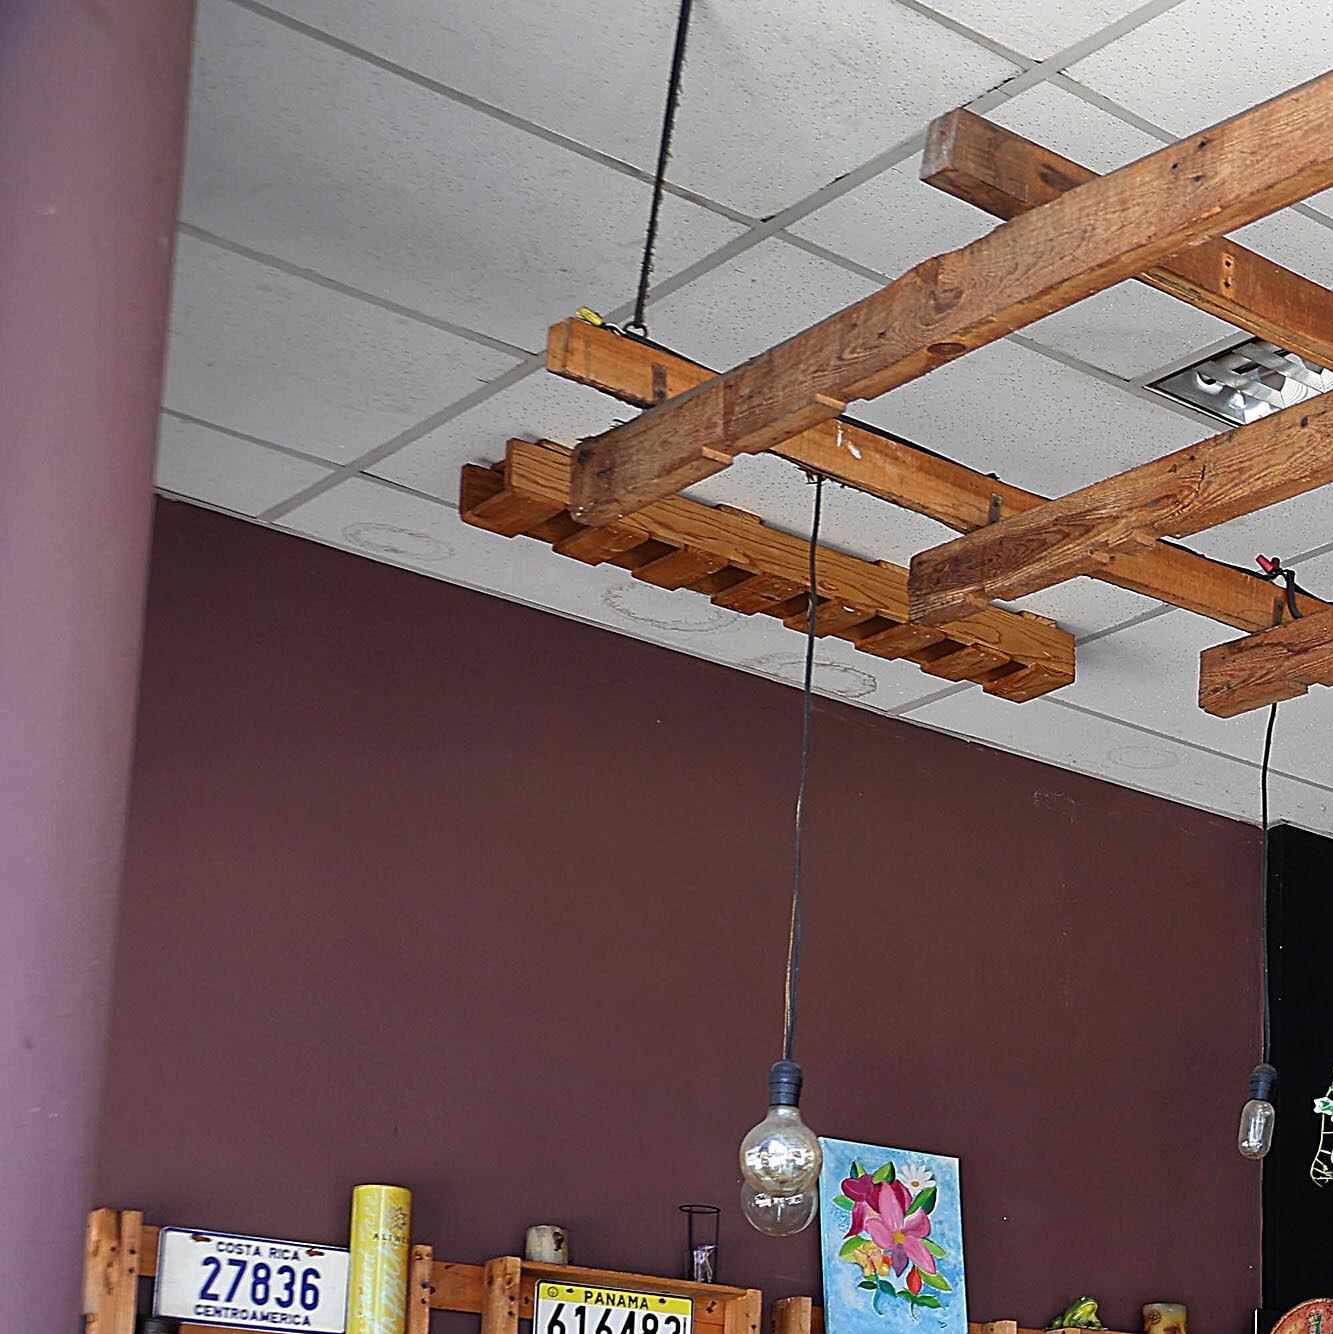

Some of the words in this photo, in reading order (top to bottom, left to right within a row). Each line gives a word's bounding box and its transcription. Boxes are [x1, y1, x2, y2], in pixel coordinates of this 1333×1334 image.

[217, 1241, 261, 1256] COSTA
[269, 1247, 301, 1261] RICA
[199, 1256, 320, 1311] 27836
[585, 1291, 649, 1309] PANAMA
[194, 1305, 311, 1327] CENTROAMERICA
